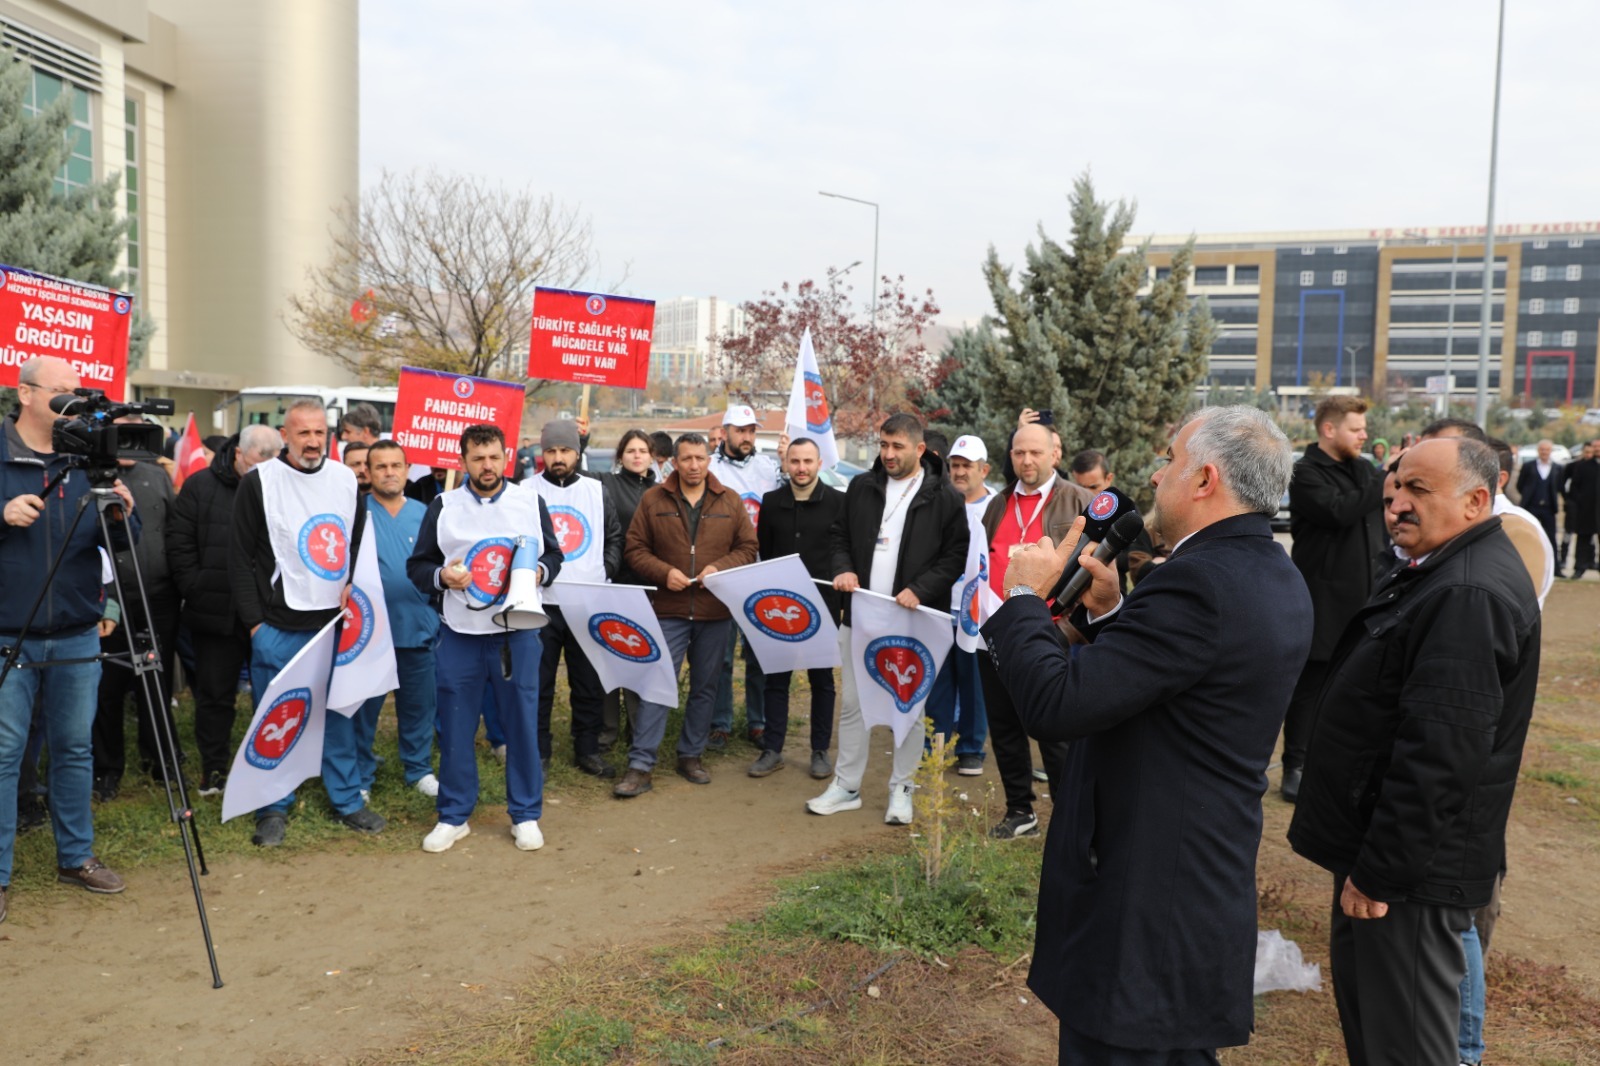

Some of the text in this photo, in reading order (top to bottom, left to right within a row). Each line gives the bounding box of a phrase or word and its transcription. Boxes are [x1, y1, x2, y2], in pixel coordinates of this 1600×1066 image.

[7, 283, 39, 297] HİZMET
[38, 287, 70, 303] İŞÇİLERİ
[8, 271, 42, 287] TÜRKİYE
[43, 280, 70, 293] SAĞLIK
[72, 285, 82, 296] VE
[21, 301, 94, 331] YAŞASIN
[533, 315, 651, 342] TÜRKİYE SAĞLIK-İŞ VAR,
[15, 321, 94, 355] ÖRGÜTLÜ
[552, 334, 628, 356] MÜCADELE VAR,
[0, 344, 114, 382] ÜCEMİZ!
[562, 353, 617, 370] UMUT VAR!
[424, 398, 496, 422] PANDEMİDE
